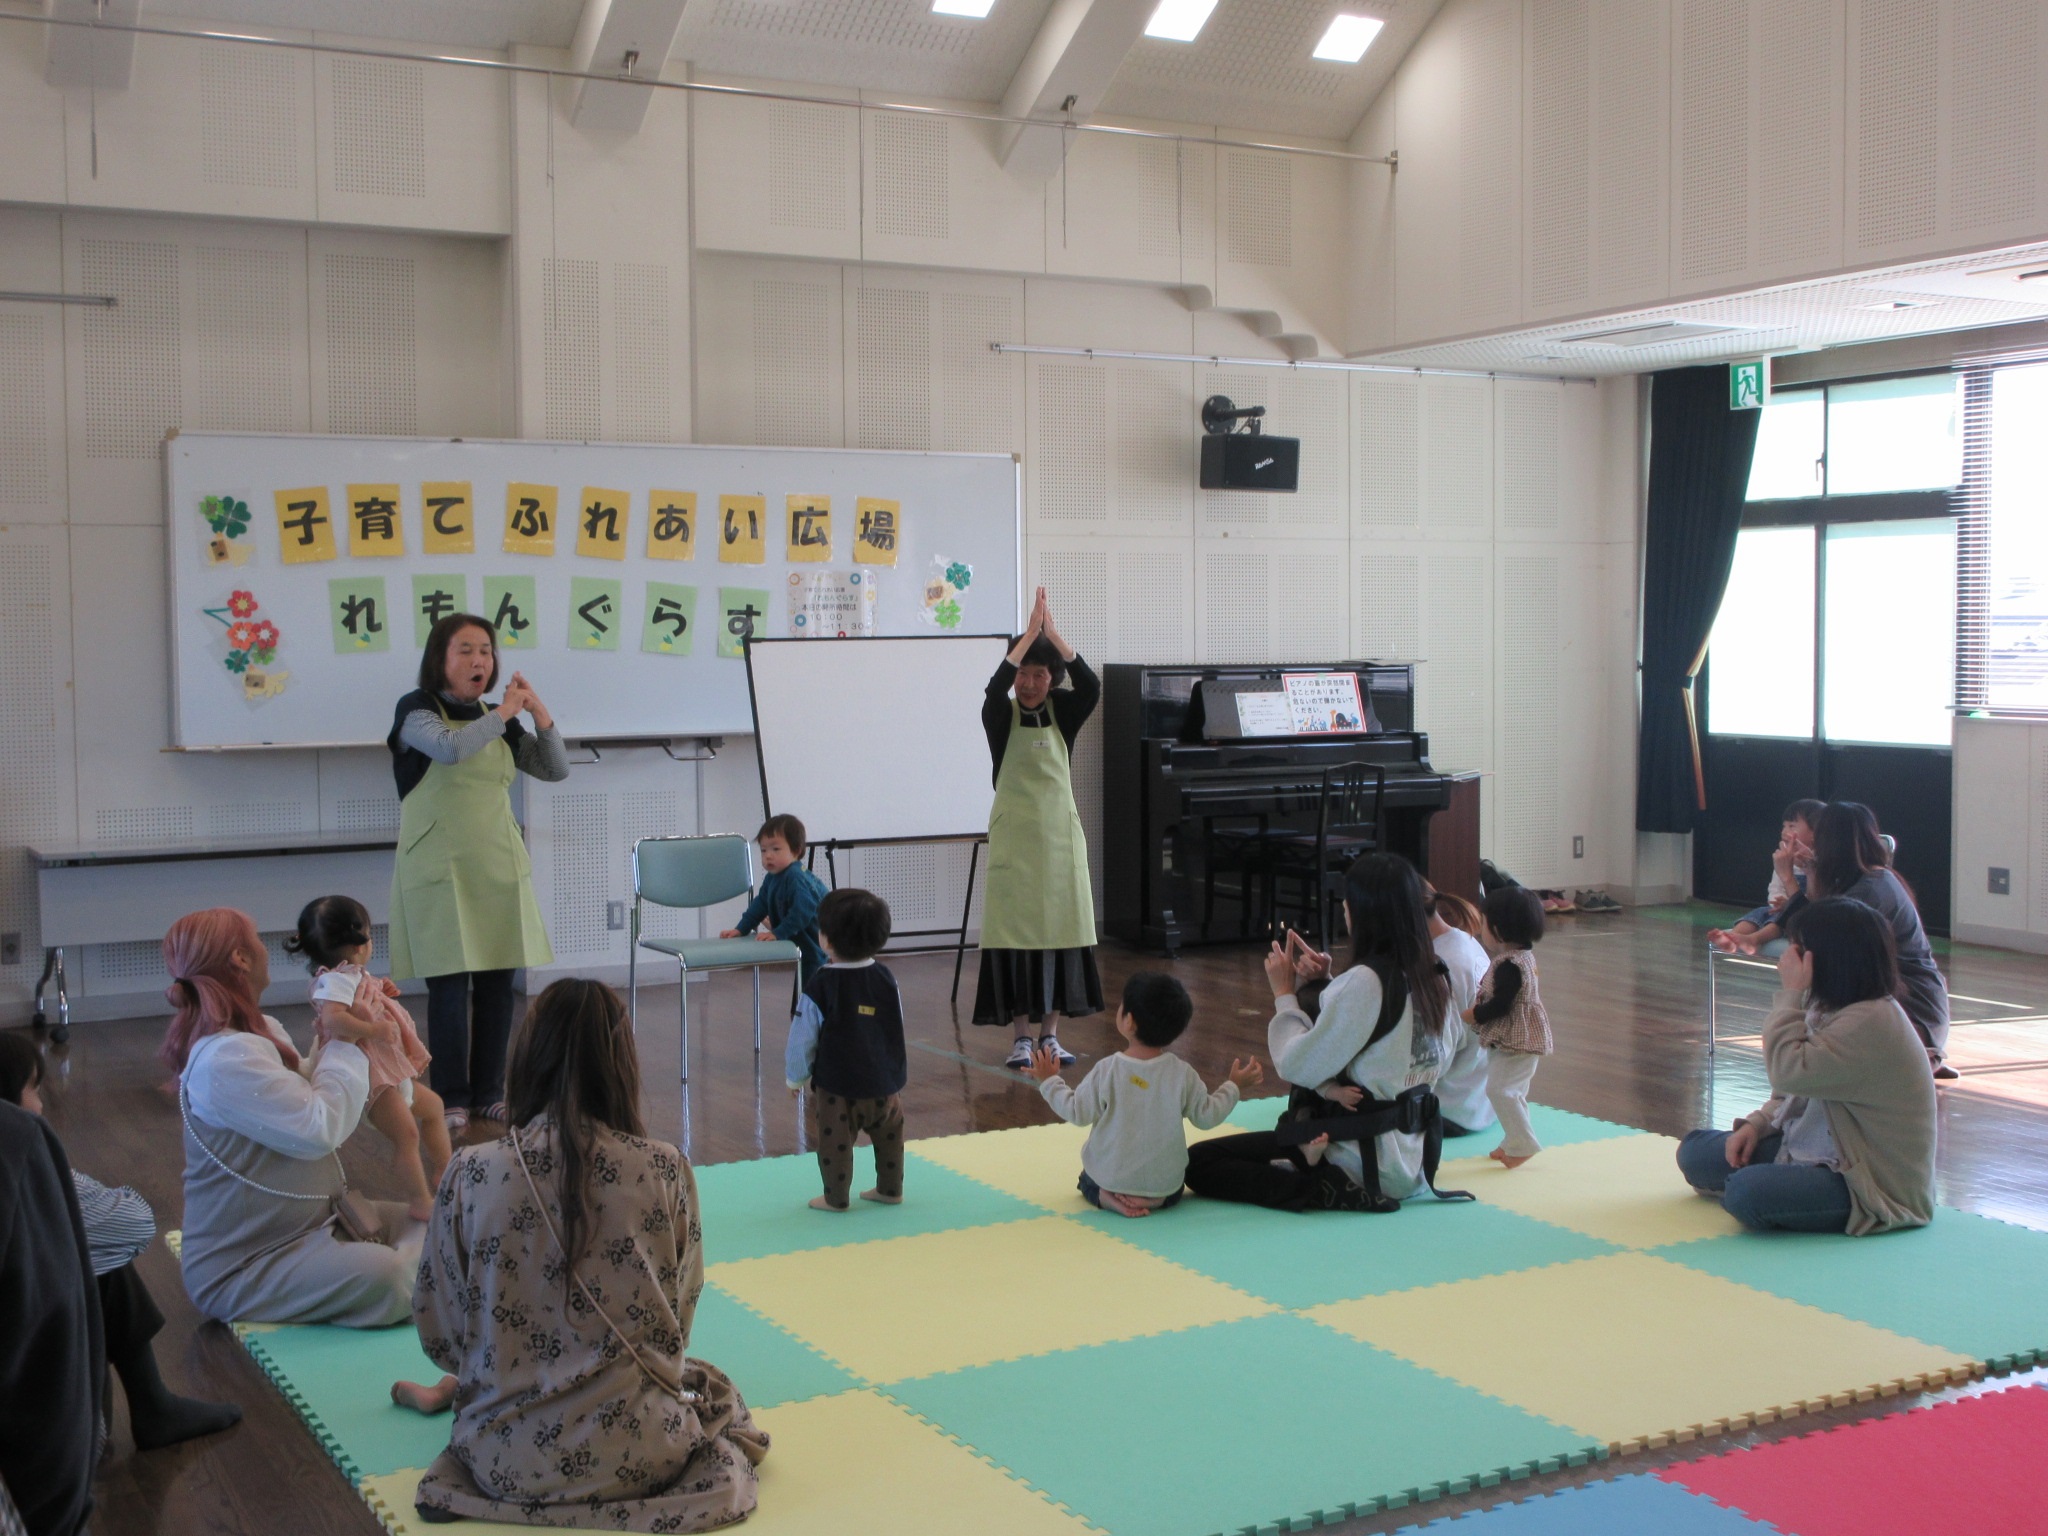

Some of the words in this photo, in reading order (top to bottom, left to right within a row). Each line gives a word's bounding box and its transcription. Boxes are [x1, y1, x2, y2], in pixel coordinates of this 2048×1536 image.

[283, 496, 896, 552] 子育てふれあい広場
